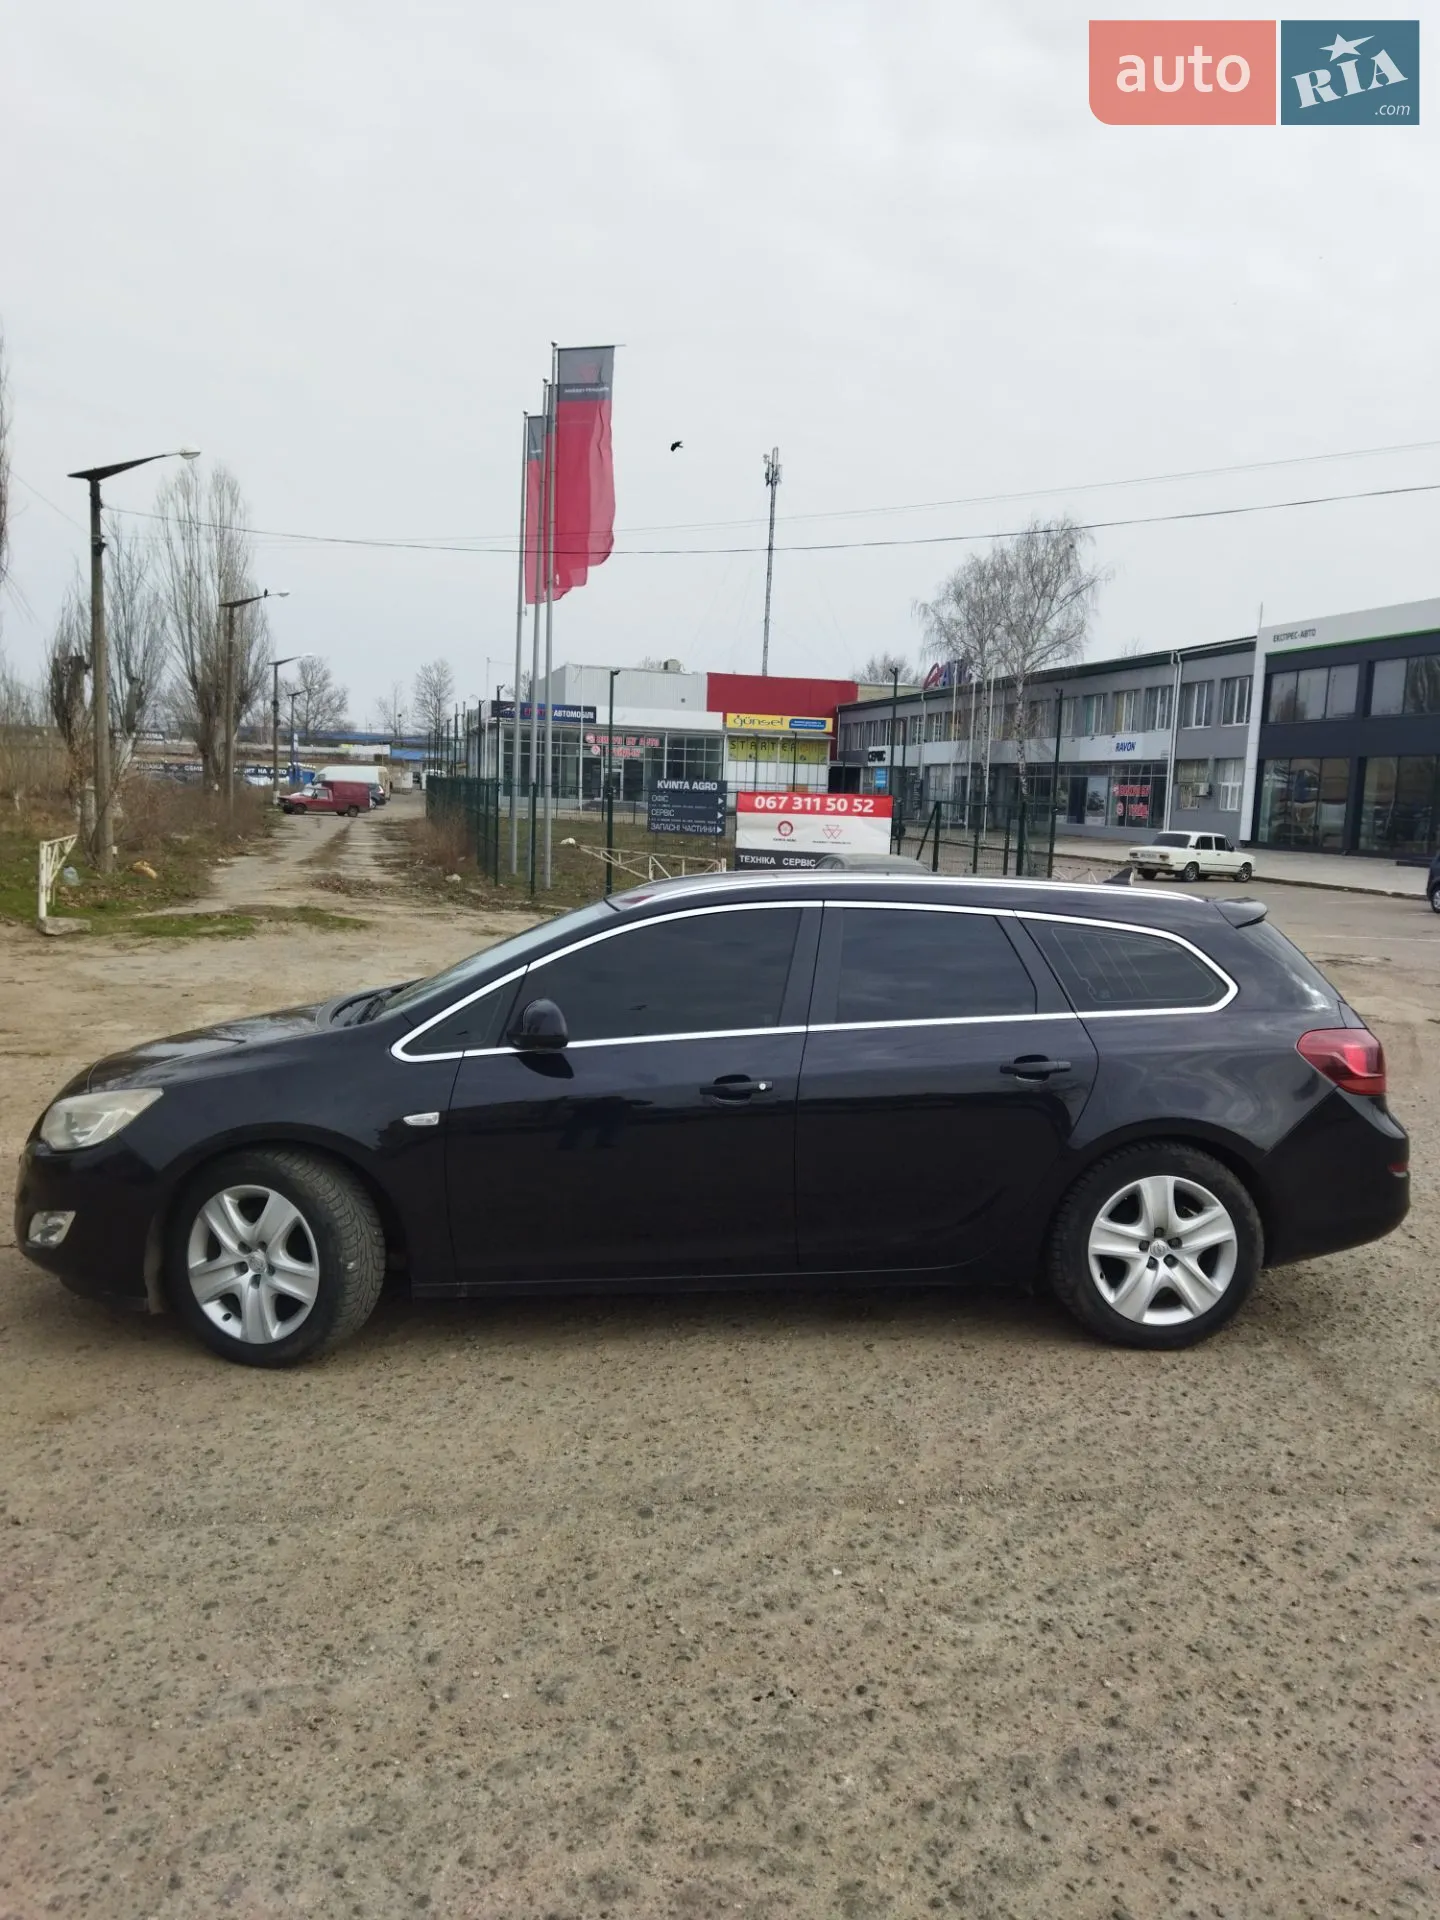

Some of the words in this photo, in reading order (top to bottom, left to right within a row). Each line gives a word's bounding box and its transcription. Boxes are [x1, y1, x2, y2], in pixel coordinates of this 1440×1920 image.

[733, 715, 784, 727] günsel
[1115, 741, 1136, 752] RAVON
[656, 780, 690, 789] KVINTA
[692, 781, 718, 791] AGRO
[754, 795, 787, 810] 067
[792, 796, 820, 811] 311
[825, 797, 848, 812] 50
[852, 799, 875, 813] 52
[651, 808, 675, 817] СЕРВІС
[650, 823, 680, 832] ЗАПАСНІ
[682, 824, 716, 833] ЧАСТИНИ
[740, 855, 776, 865] ТЕХНІКА
[782, 857, 816, 867] СЕРВІС
